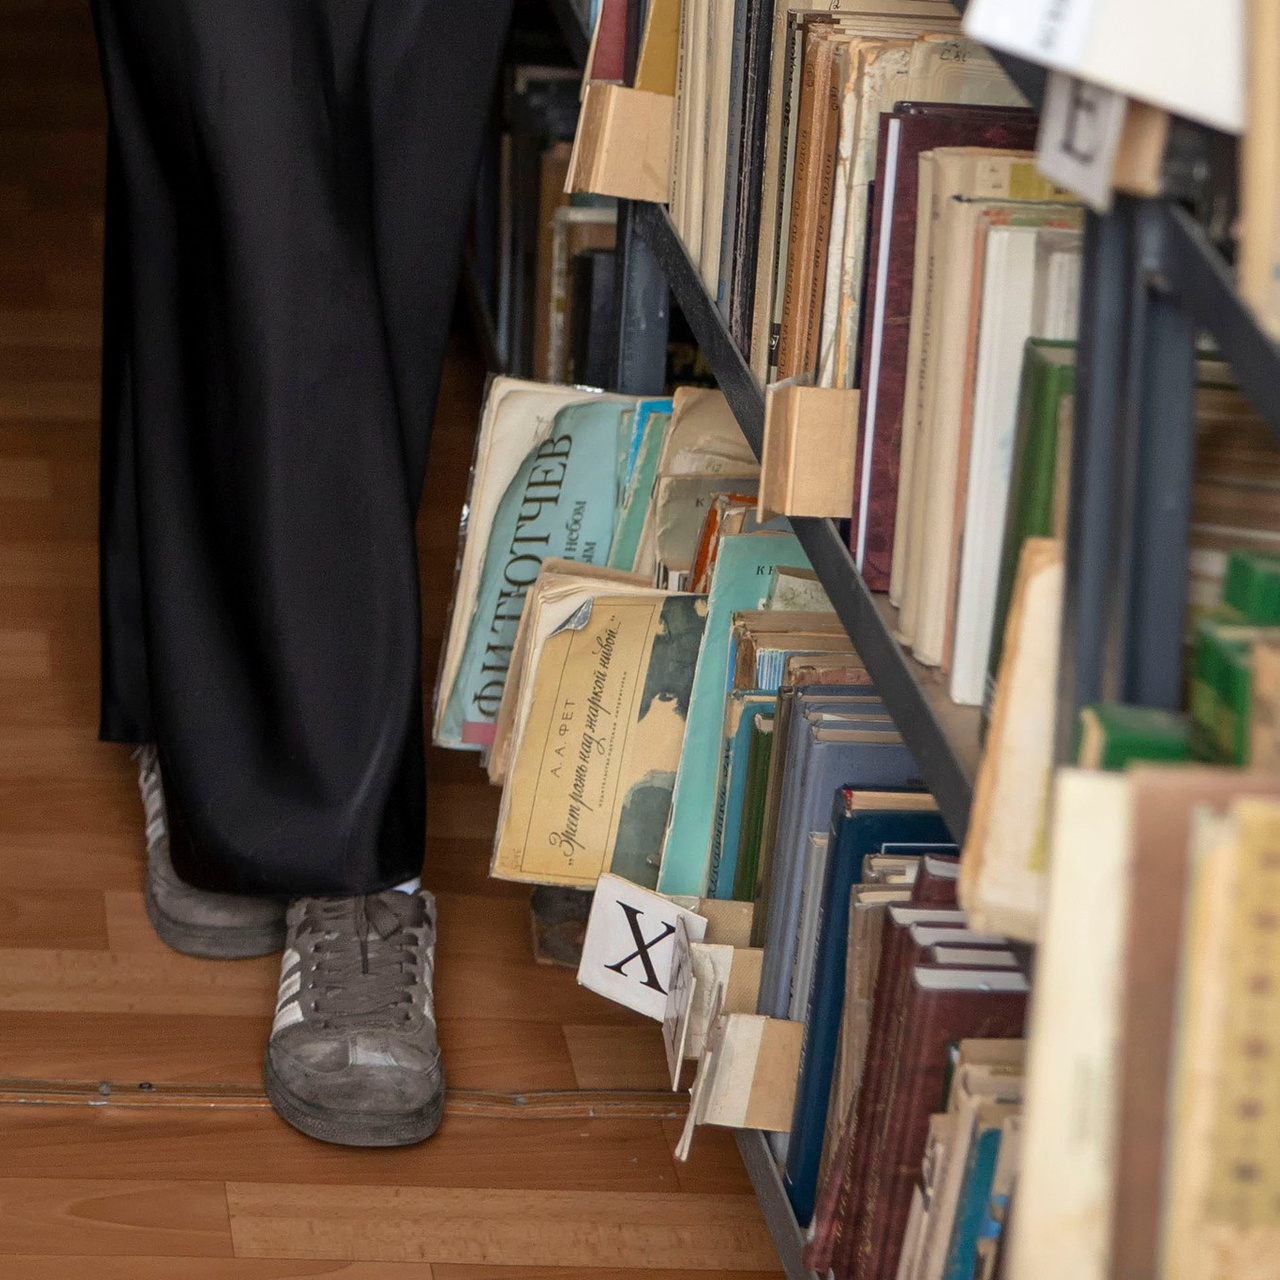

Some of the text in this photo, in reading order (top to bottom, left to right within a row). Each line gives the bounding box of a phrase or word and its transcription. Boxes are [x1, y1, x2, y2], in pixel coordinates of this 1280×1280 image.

[797, 129, 809, 182] ГОДОВ
[557, 700, 577, 739] ФЕТ
[584, 670, 613, 737] жаркой
[604, 900, 677, 996] Х
